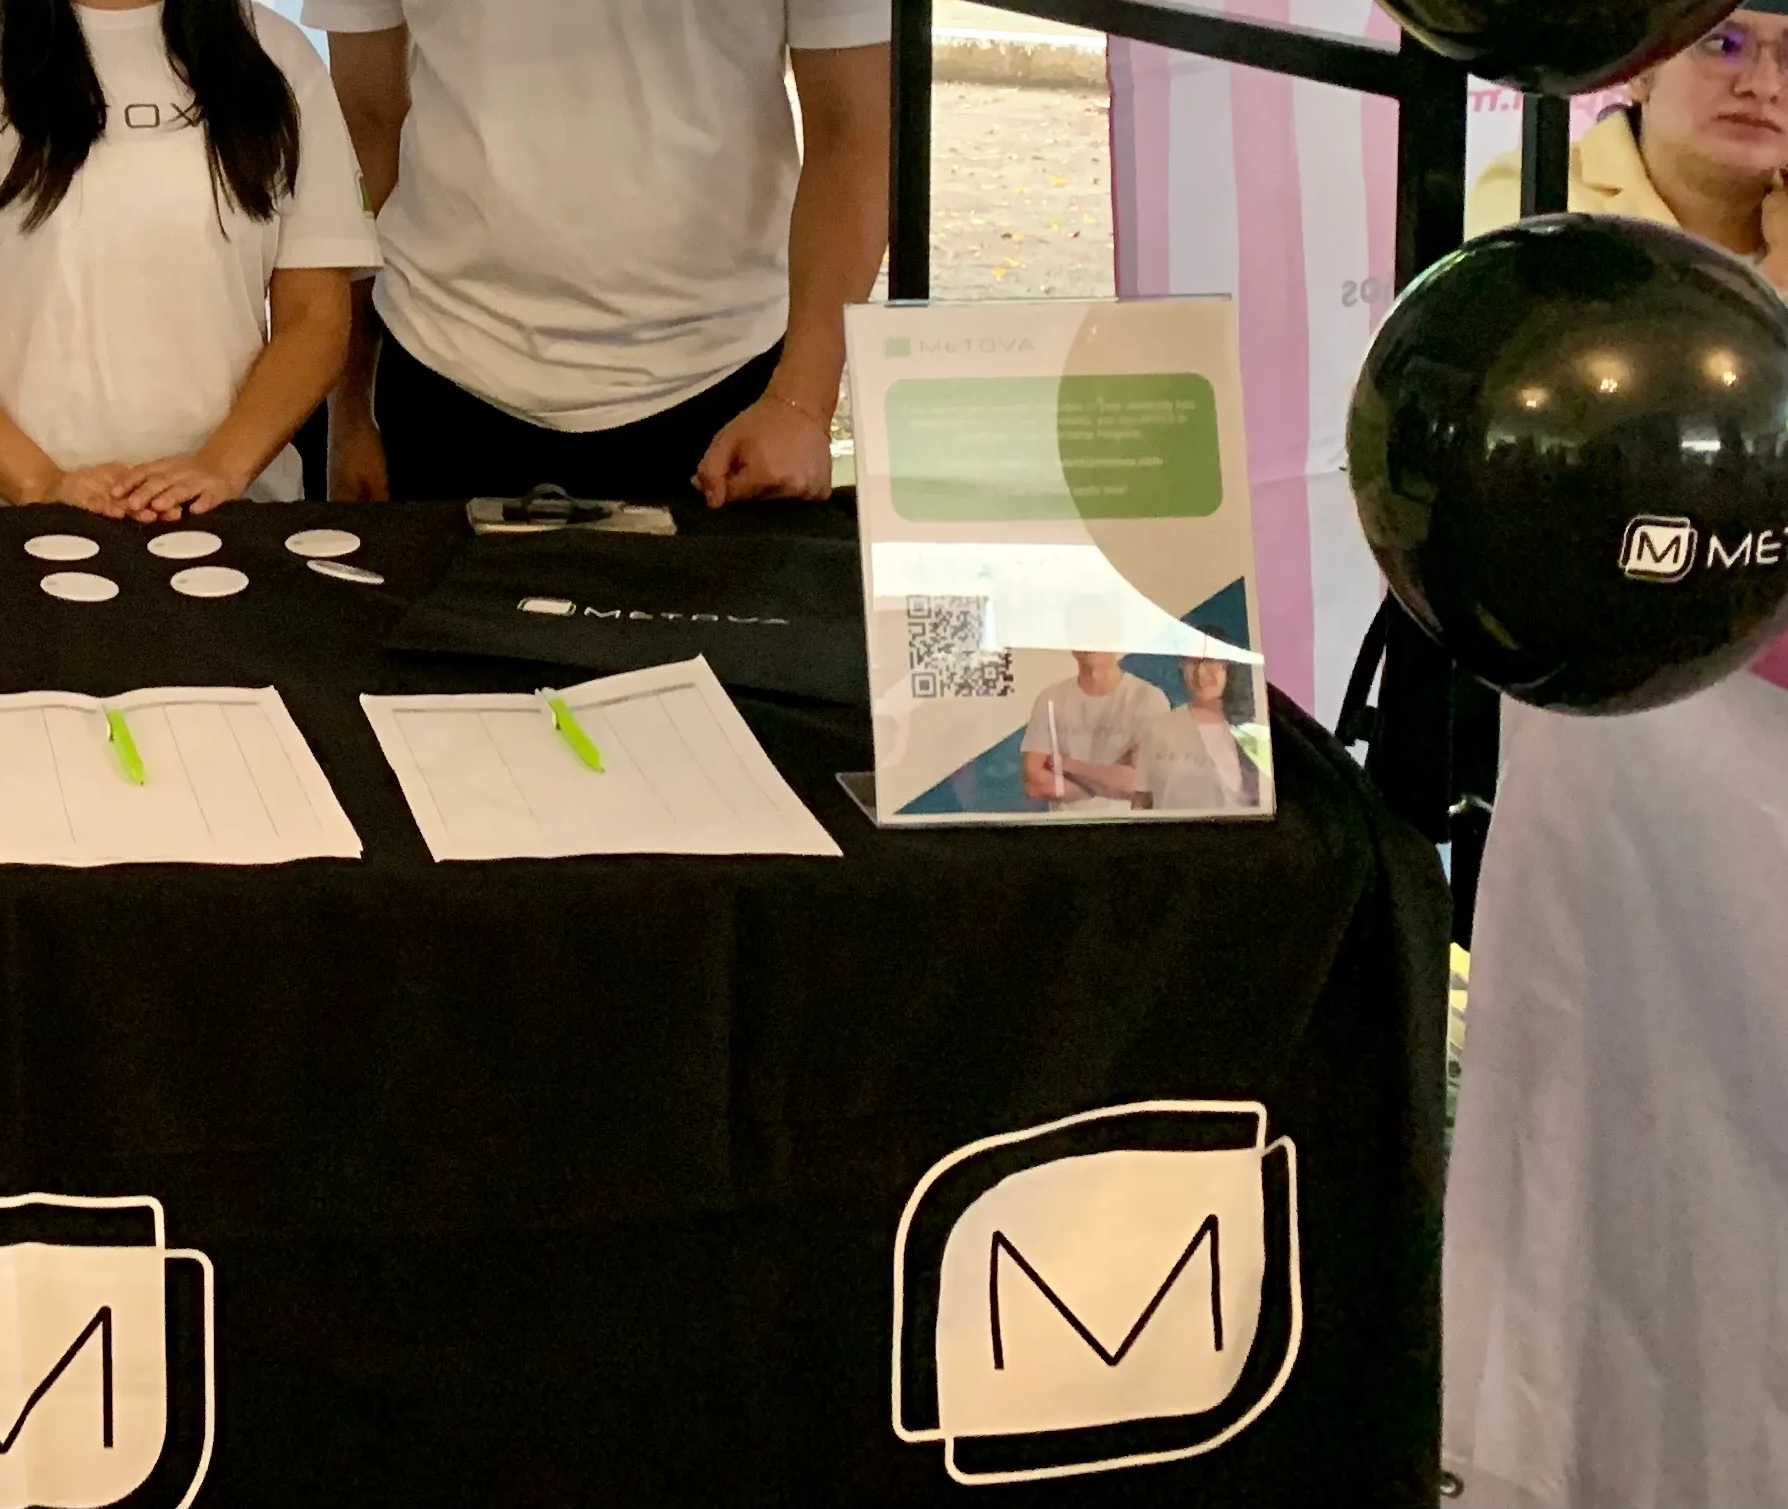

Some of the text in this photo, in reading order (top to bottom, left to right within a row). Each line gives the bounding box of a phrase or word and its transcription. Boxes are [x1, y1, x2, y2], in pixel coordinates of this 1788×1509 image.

[919, 335, 1036, 355] METOVA
[1706, 526, 1788, 570] ME
[989, 1214, 1224, 1371] M
